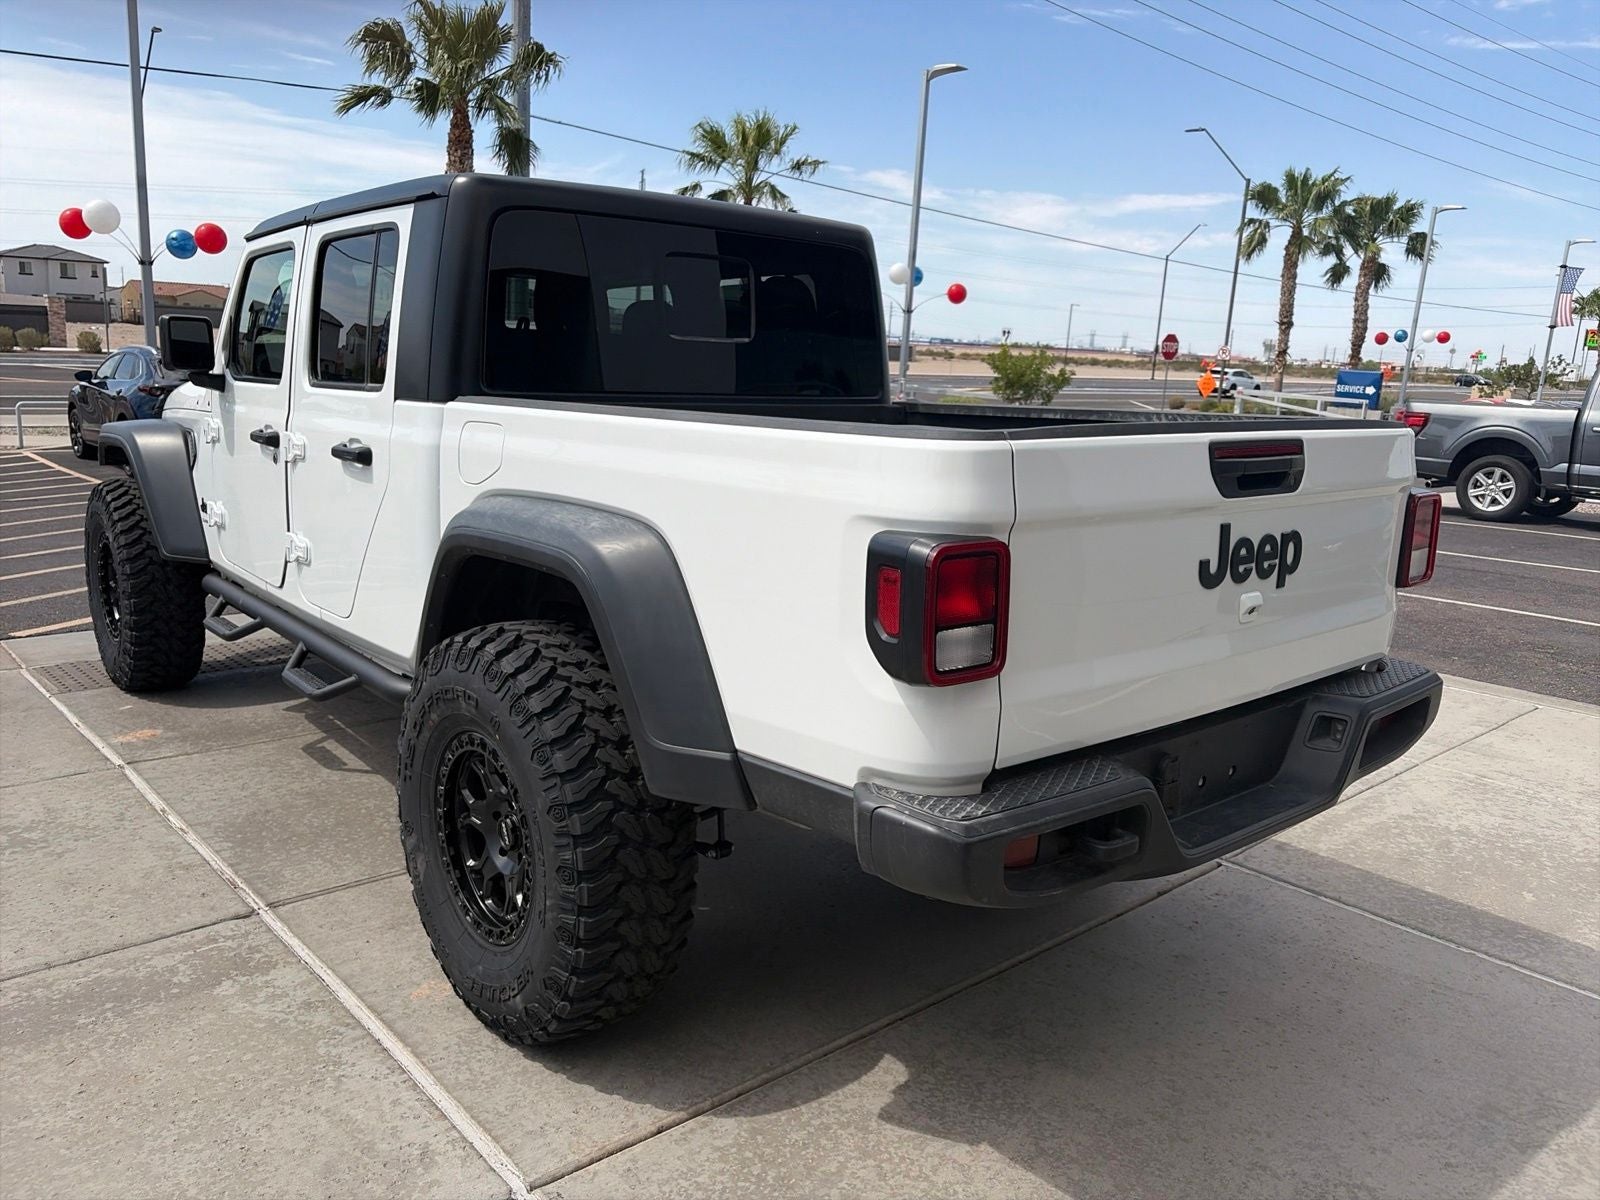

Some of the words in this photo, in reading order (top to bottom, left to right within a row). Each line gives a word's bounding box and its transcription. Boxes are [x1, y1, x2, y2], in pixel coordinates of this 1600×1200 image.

[1162, 341, 1179, 353] STOP
[1336, 384, 1365, 394] SERVICE
[1198, 522, 1303, 590] Jeep
